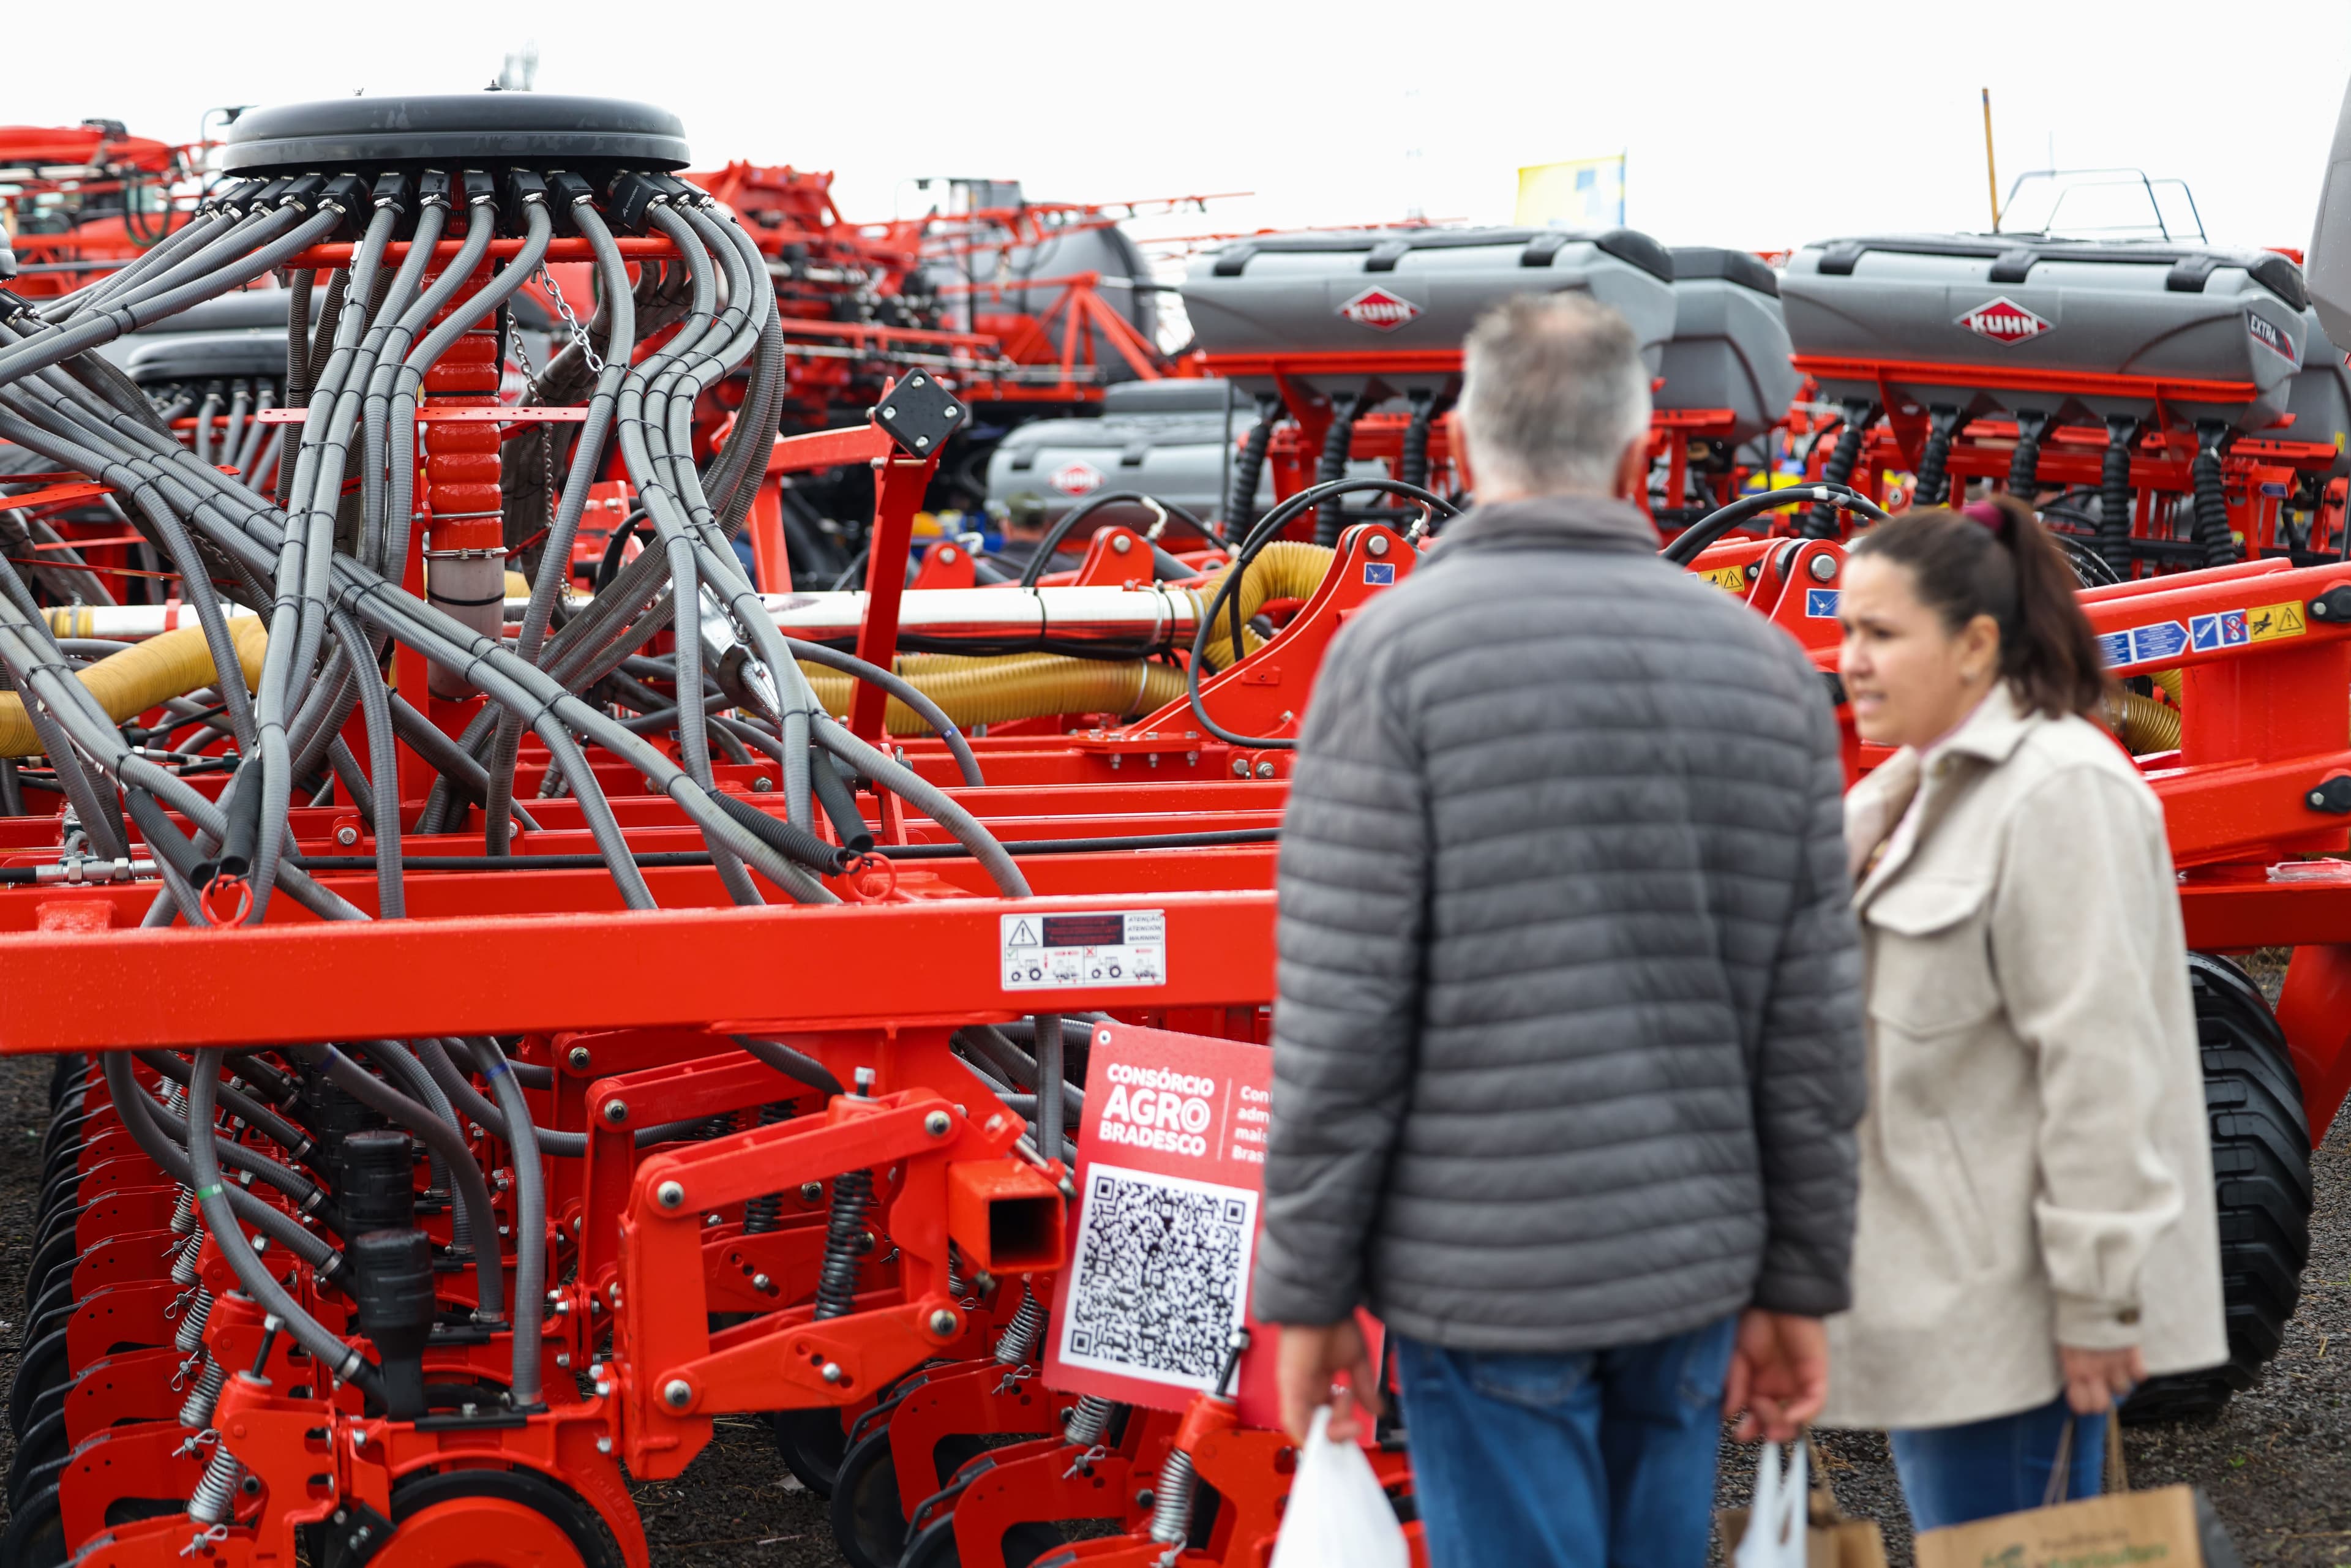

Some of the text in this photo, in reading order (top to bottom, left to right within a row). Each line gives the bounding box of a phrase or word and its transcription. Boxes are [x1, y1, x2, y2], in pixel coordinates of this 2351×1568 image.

[1349, 304, 1412, 321] KUHN
[1970, 313, 2039, 336] KUHN
[2251, 313, 2276, 345] EXTRA
[1107, 1063, 1215, 1097] CONSÓRCIO
[1240, 1085, 1273, 1103] Con
[1102, 1084, 1210, 1133] AGRO
[1237, 1106, 1271, 1123] adm
[1098, 1119, 1207, 1157] BRADESCO
[1232, 1144, 1266, 1163] Bras
